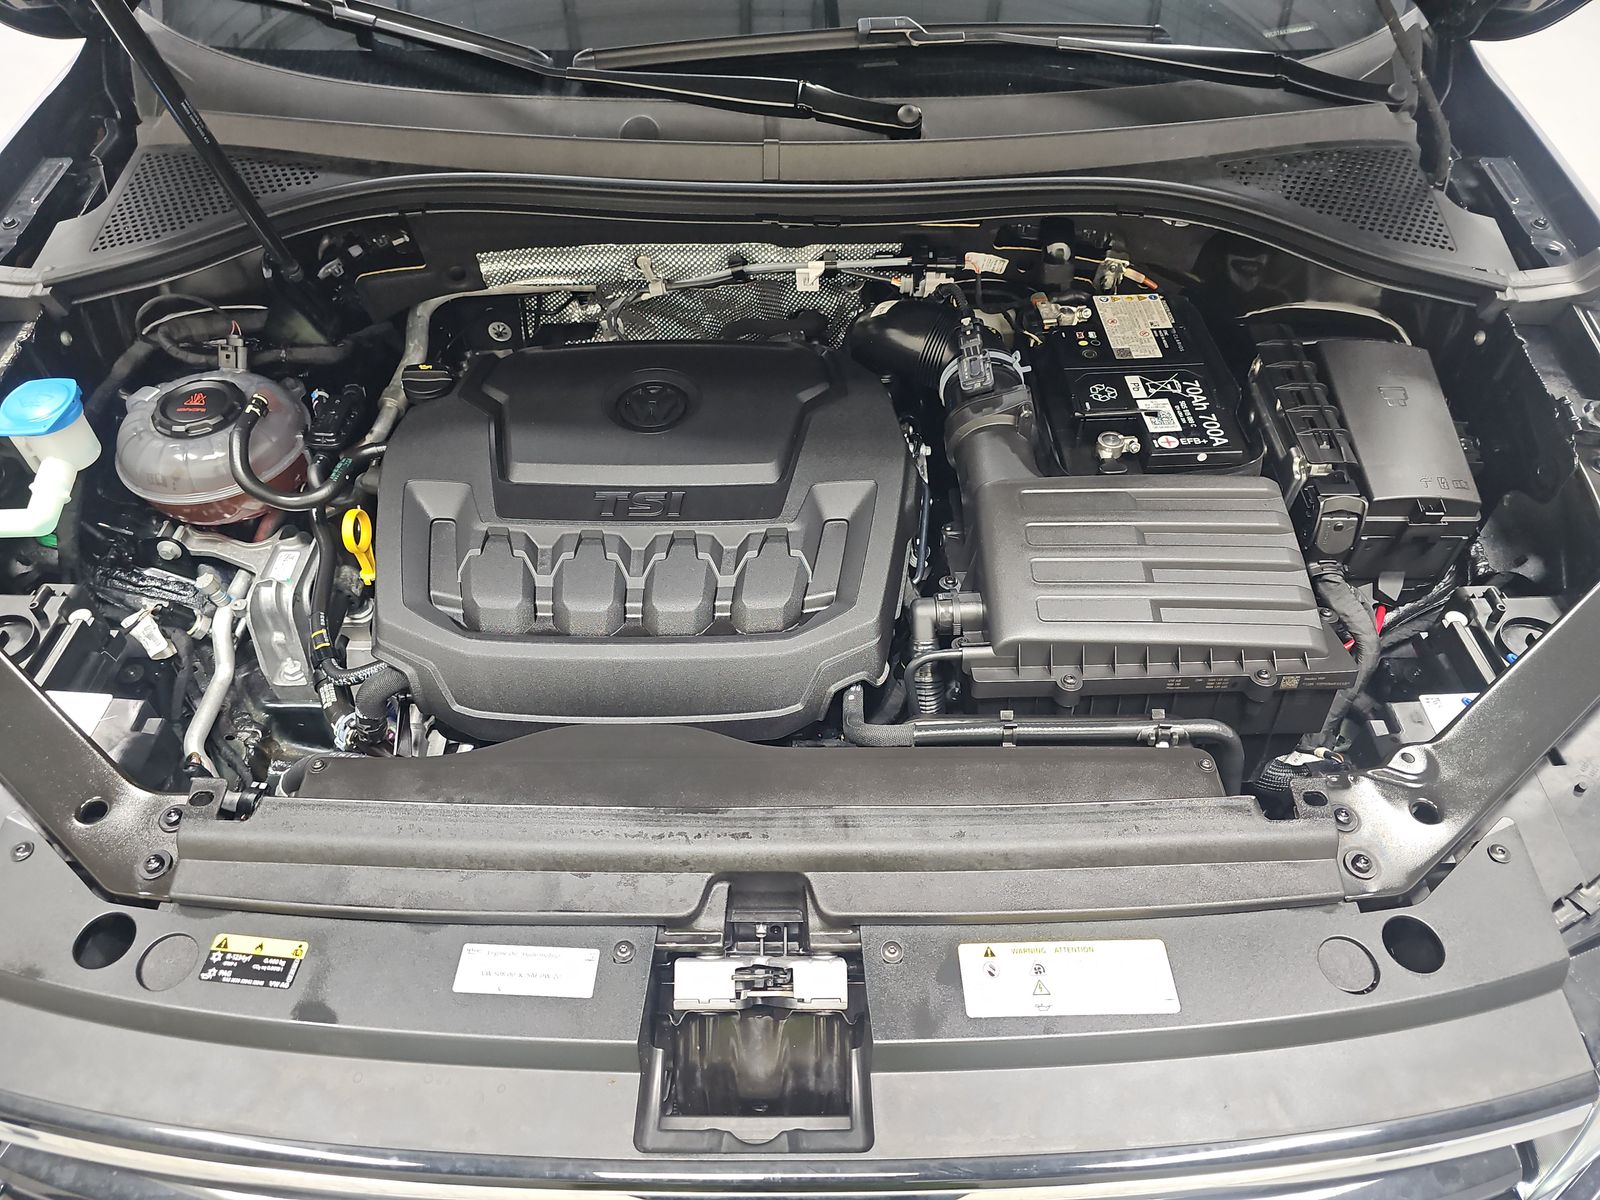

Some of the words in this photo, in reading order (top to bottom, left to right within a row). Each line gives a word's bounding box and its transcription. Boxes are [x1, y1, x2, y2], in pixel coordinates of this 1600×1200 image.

[1131, 382, 1140, 391] Pb
[1182, 380, 1210, 411] 70Ah
[1180, 437, 1208, 445] EFB+
[1198, 413, 1229, 447] 700A
[593, 491, 686, 517] TSI
